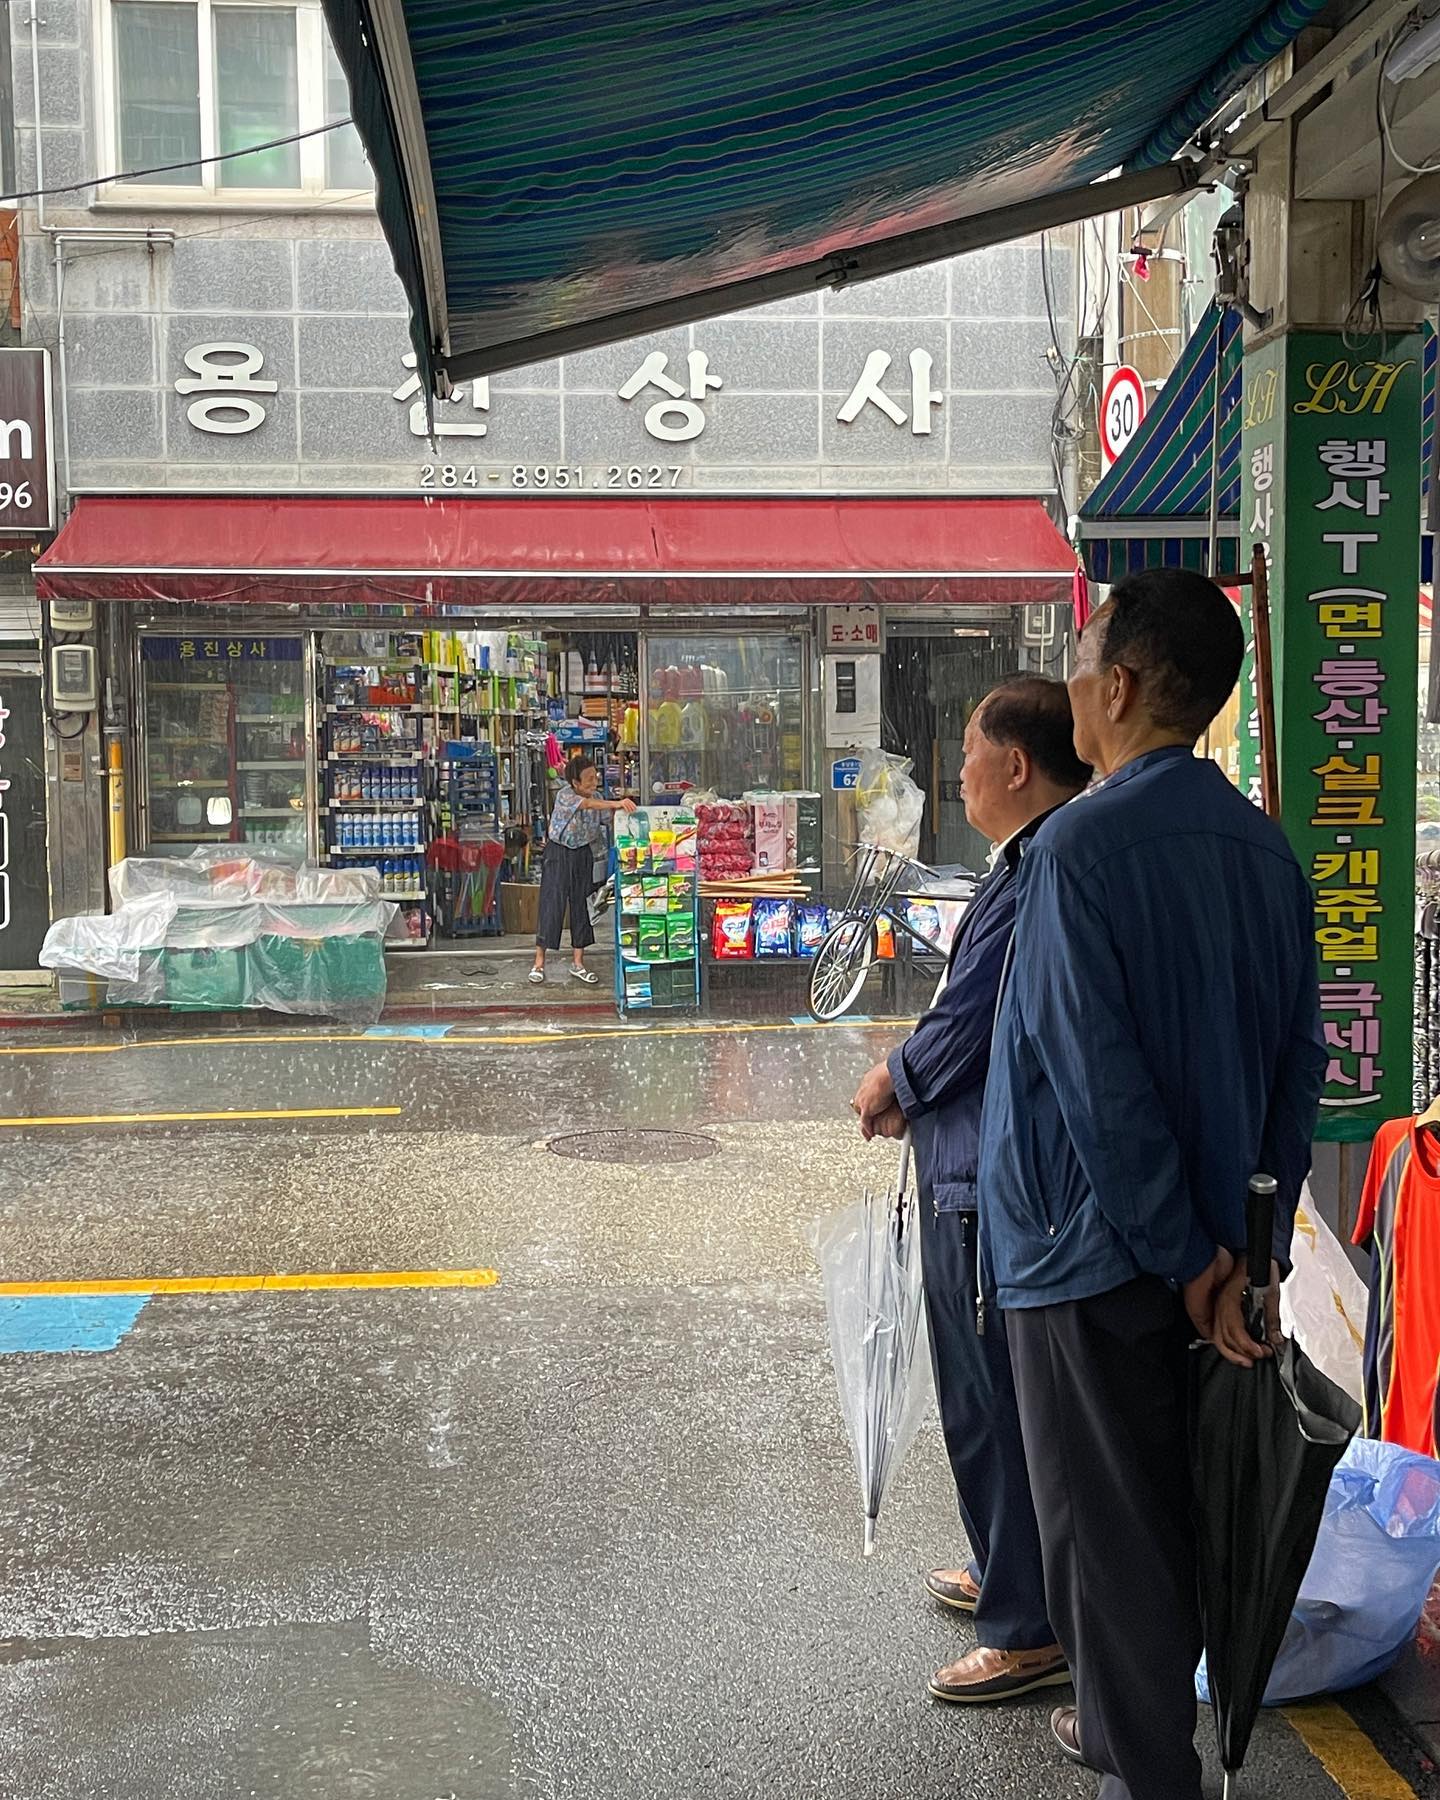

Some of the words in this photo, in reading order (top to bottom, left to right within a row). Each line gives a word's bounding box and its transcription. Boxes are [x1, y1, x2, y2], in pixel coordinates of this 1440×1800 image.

[1111, 394, 1134, 441] 30
[1293, 360, 1416, 415] LH
[1250, 443, 1274, 538] 행사
[1315, 440, 1390, 516] 행사
